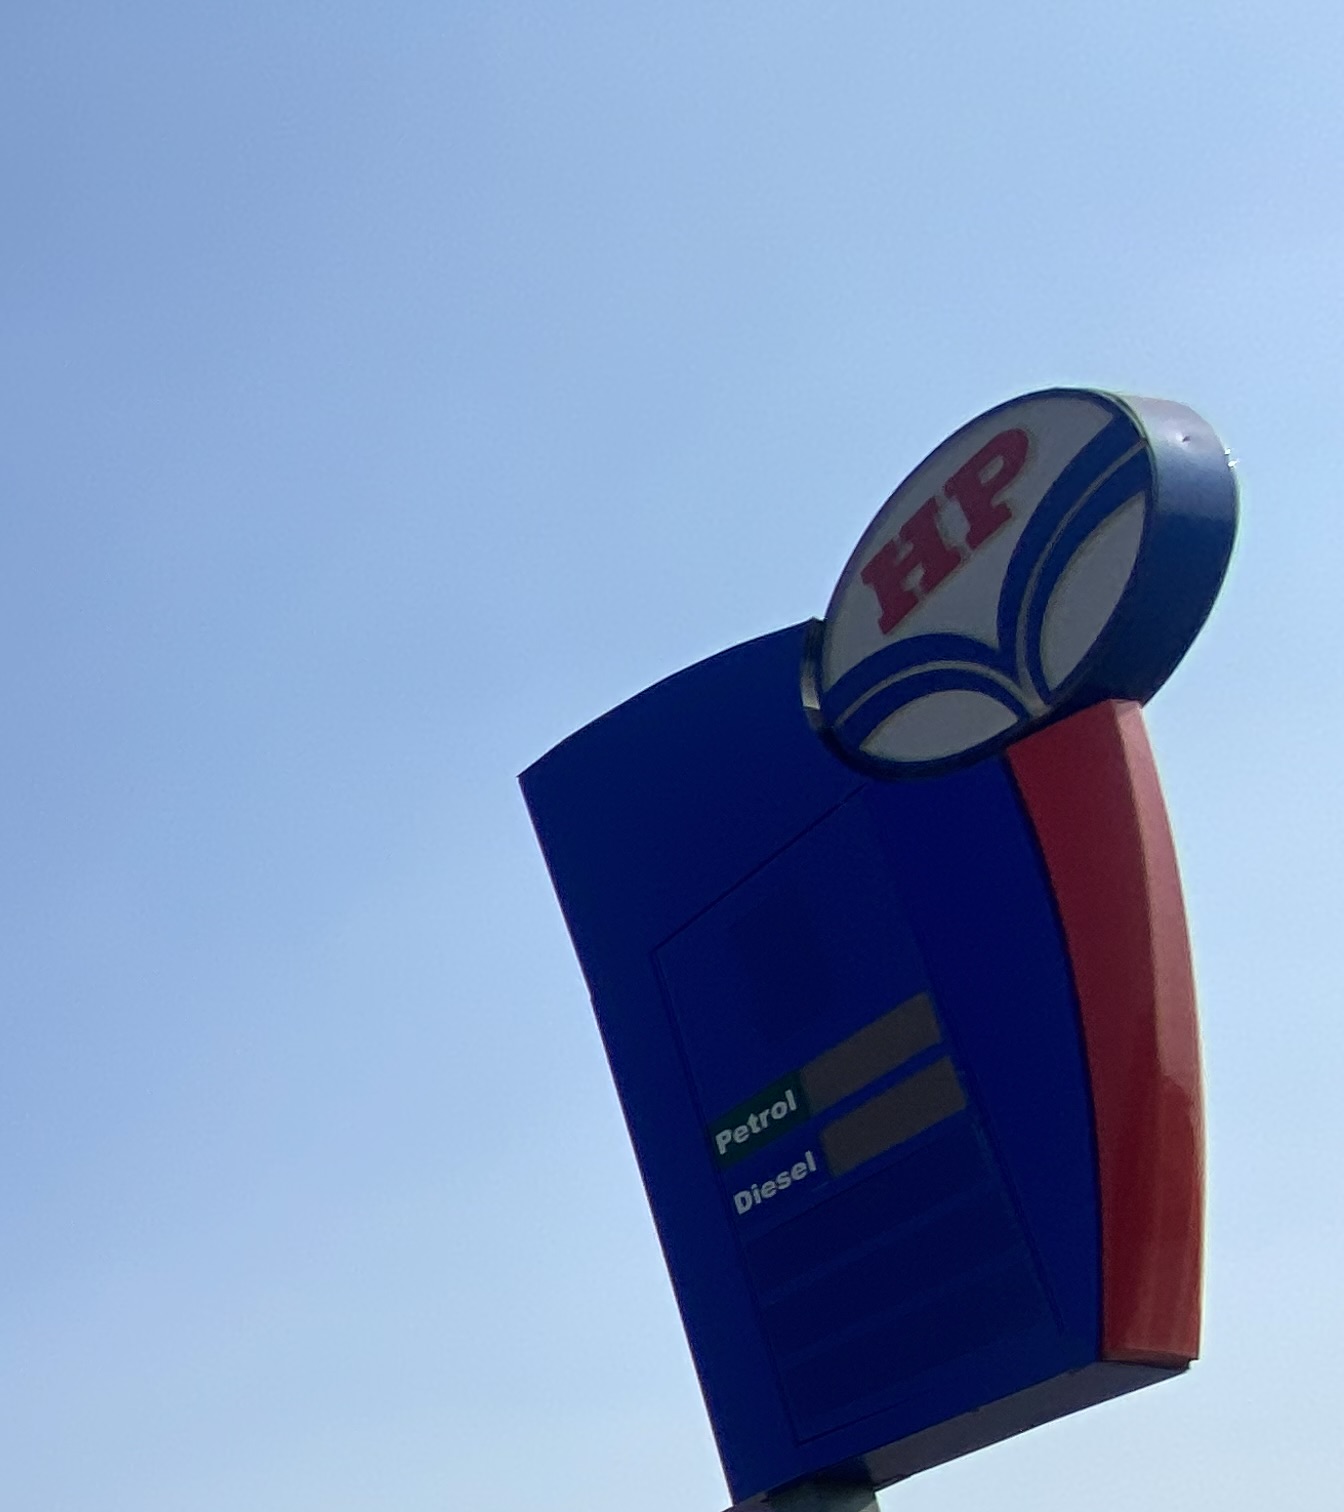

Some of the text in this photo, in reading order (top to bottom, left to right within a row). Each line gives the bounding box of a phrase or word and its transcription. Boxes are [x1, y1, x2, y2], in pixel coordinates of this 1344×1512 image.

[860, 427, 1031, 636] HP
[714, 1089, 798, 1156] Petrol
[733, 1150, 818, 1216] Diesel
